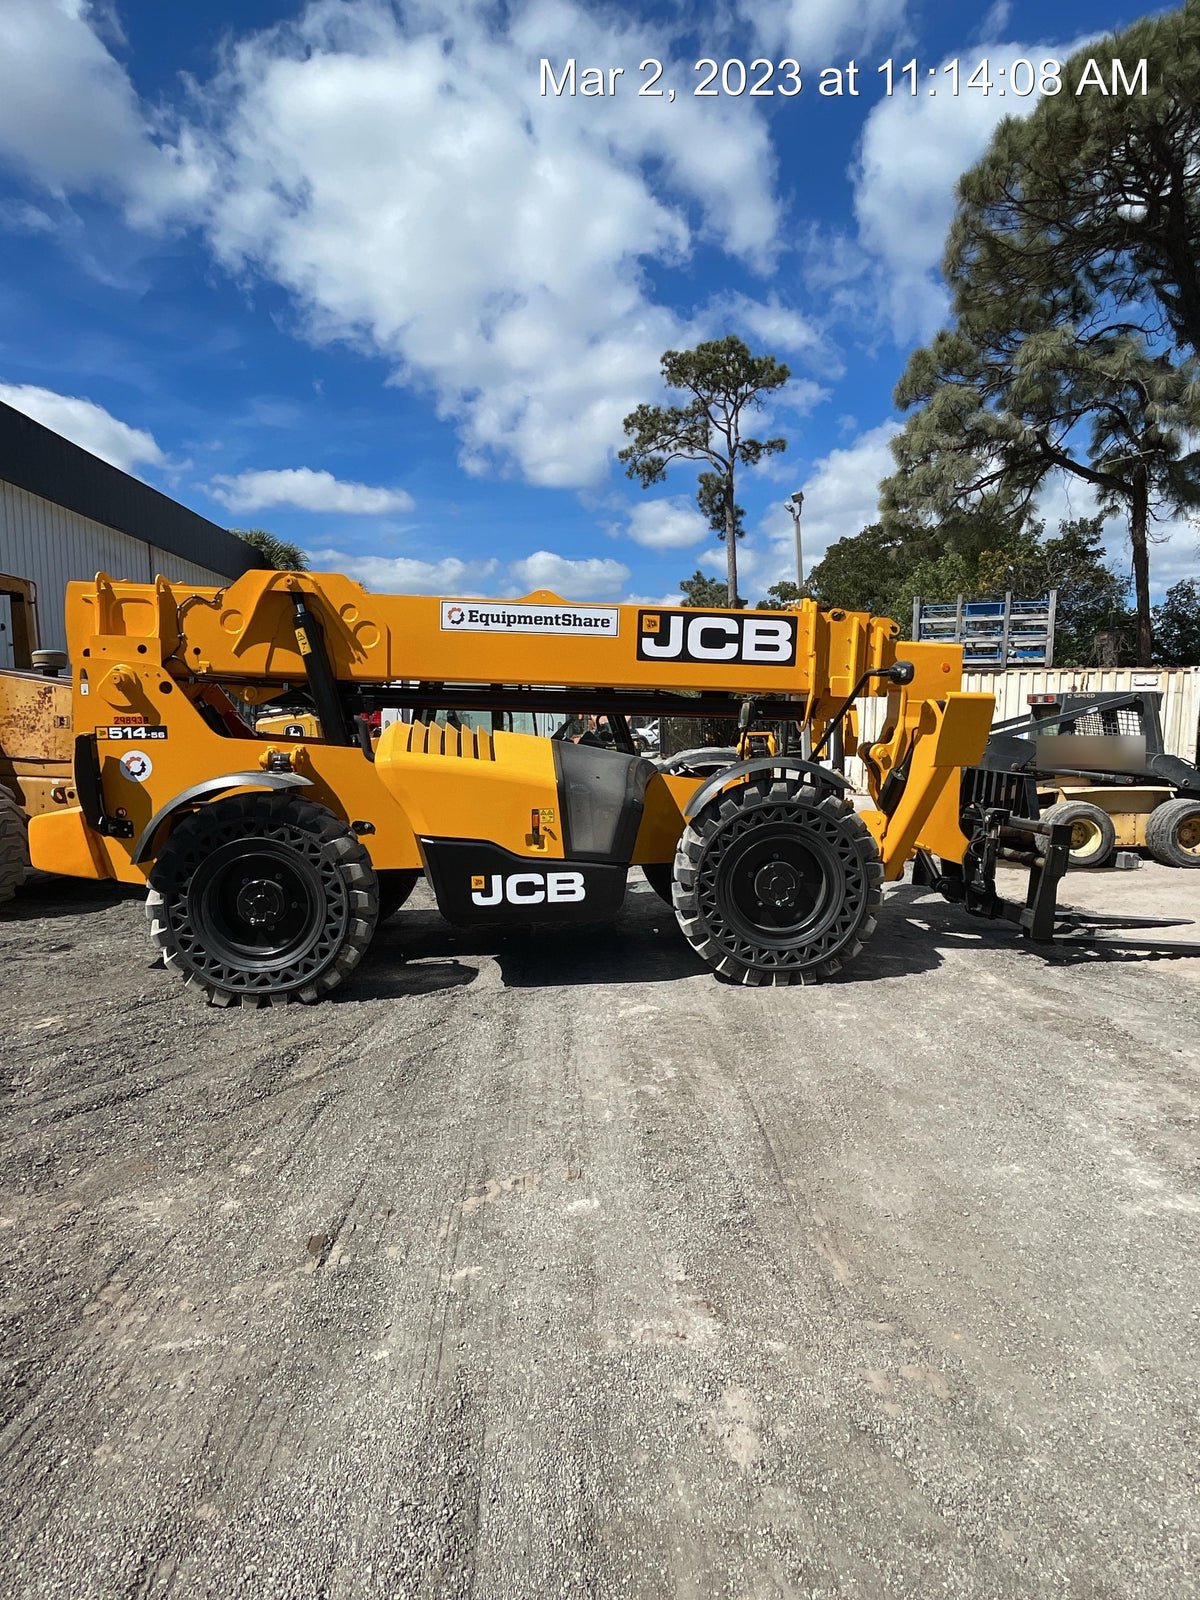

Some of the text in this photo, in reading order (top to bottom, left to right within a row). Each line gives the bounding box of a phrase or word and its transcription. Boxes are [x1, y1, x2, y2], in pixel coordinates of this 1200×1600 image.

[468, 610, 611, 628] EquipmentShare
[641, 615, 793, 662] JCB
[471, 871, 586, 906] JCB
